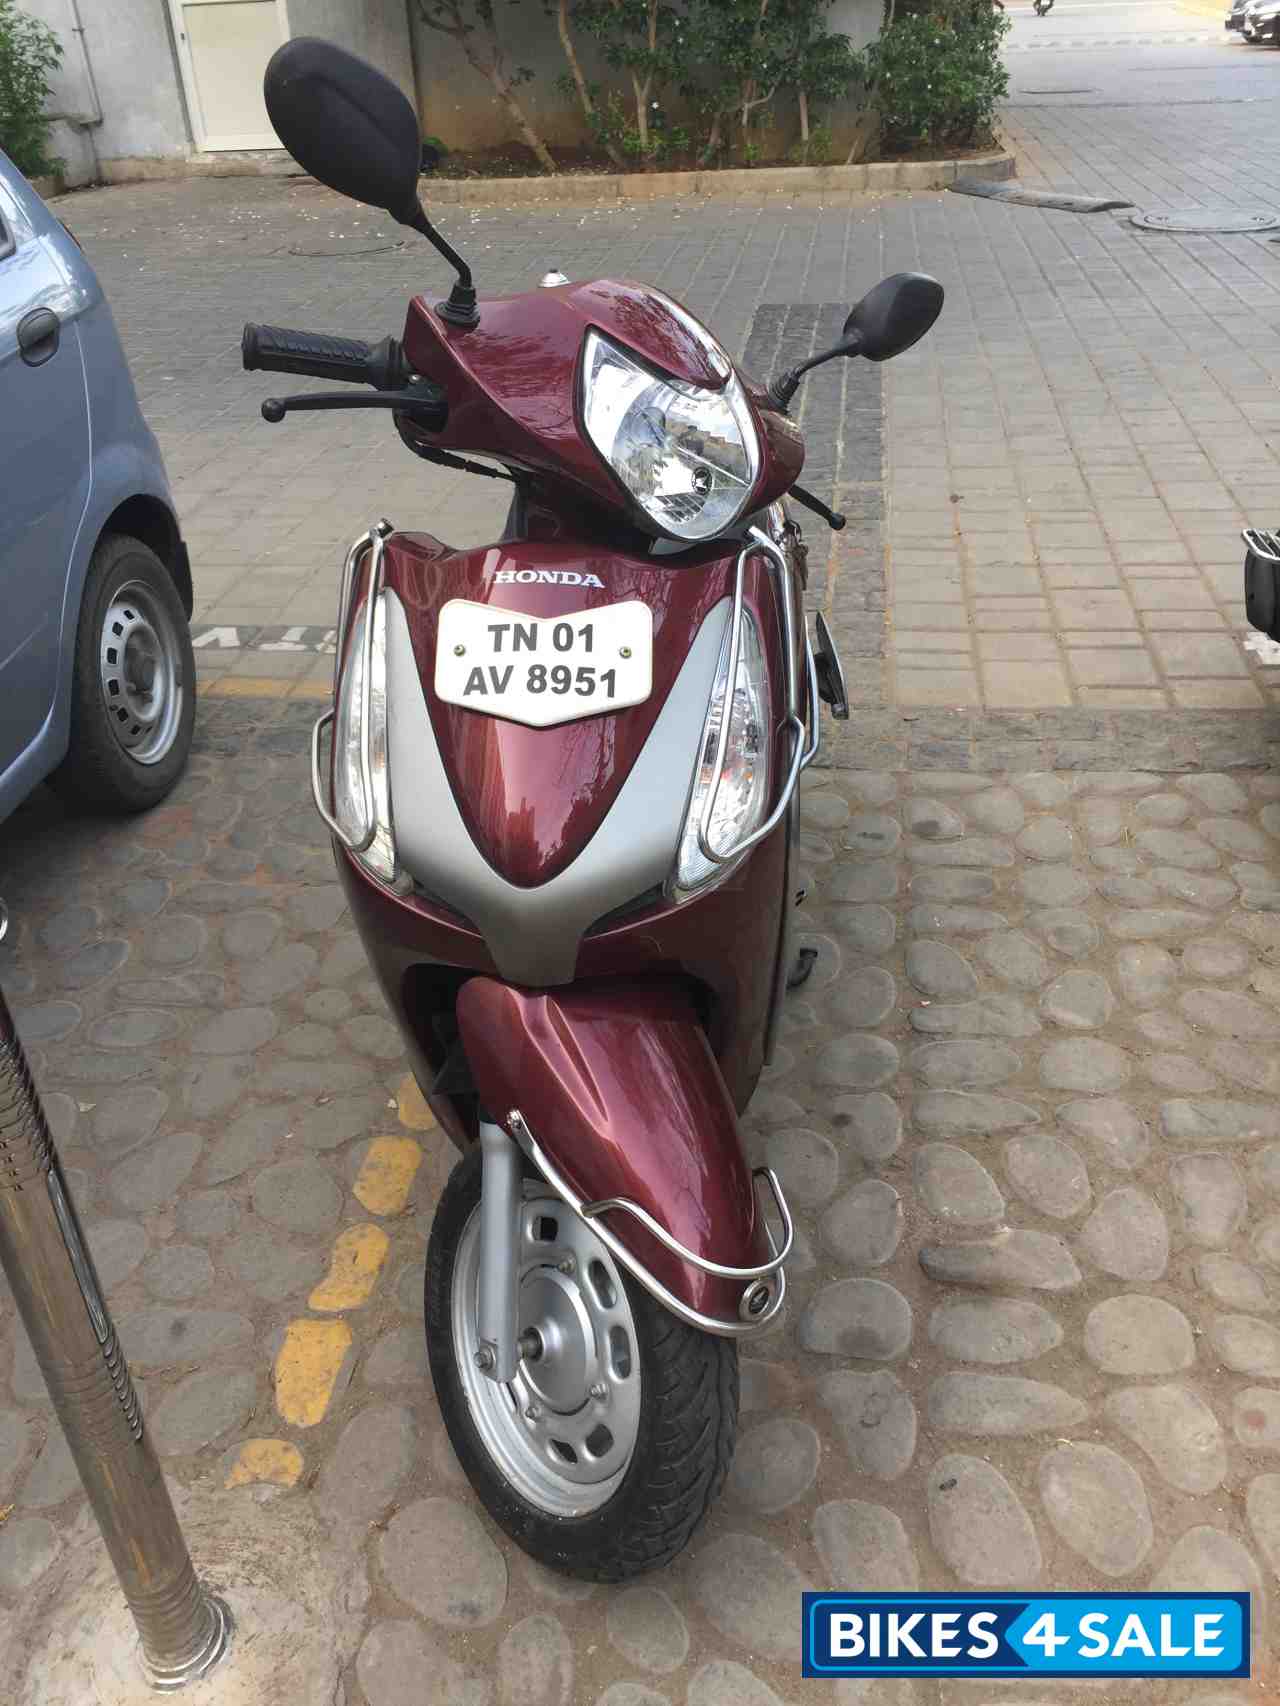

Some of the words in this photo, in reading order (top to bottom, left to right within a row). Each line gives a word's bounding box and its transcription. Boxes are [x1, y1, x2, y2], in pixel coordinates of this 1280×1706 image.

[493, 570, 605, 589] HONDA
[488, 623, 538, 652] TN
[553, 623, 593, 652] 01
[463, 665, 514, 696] AV
[526, 664, 616, 698] 8951
